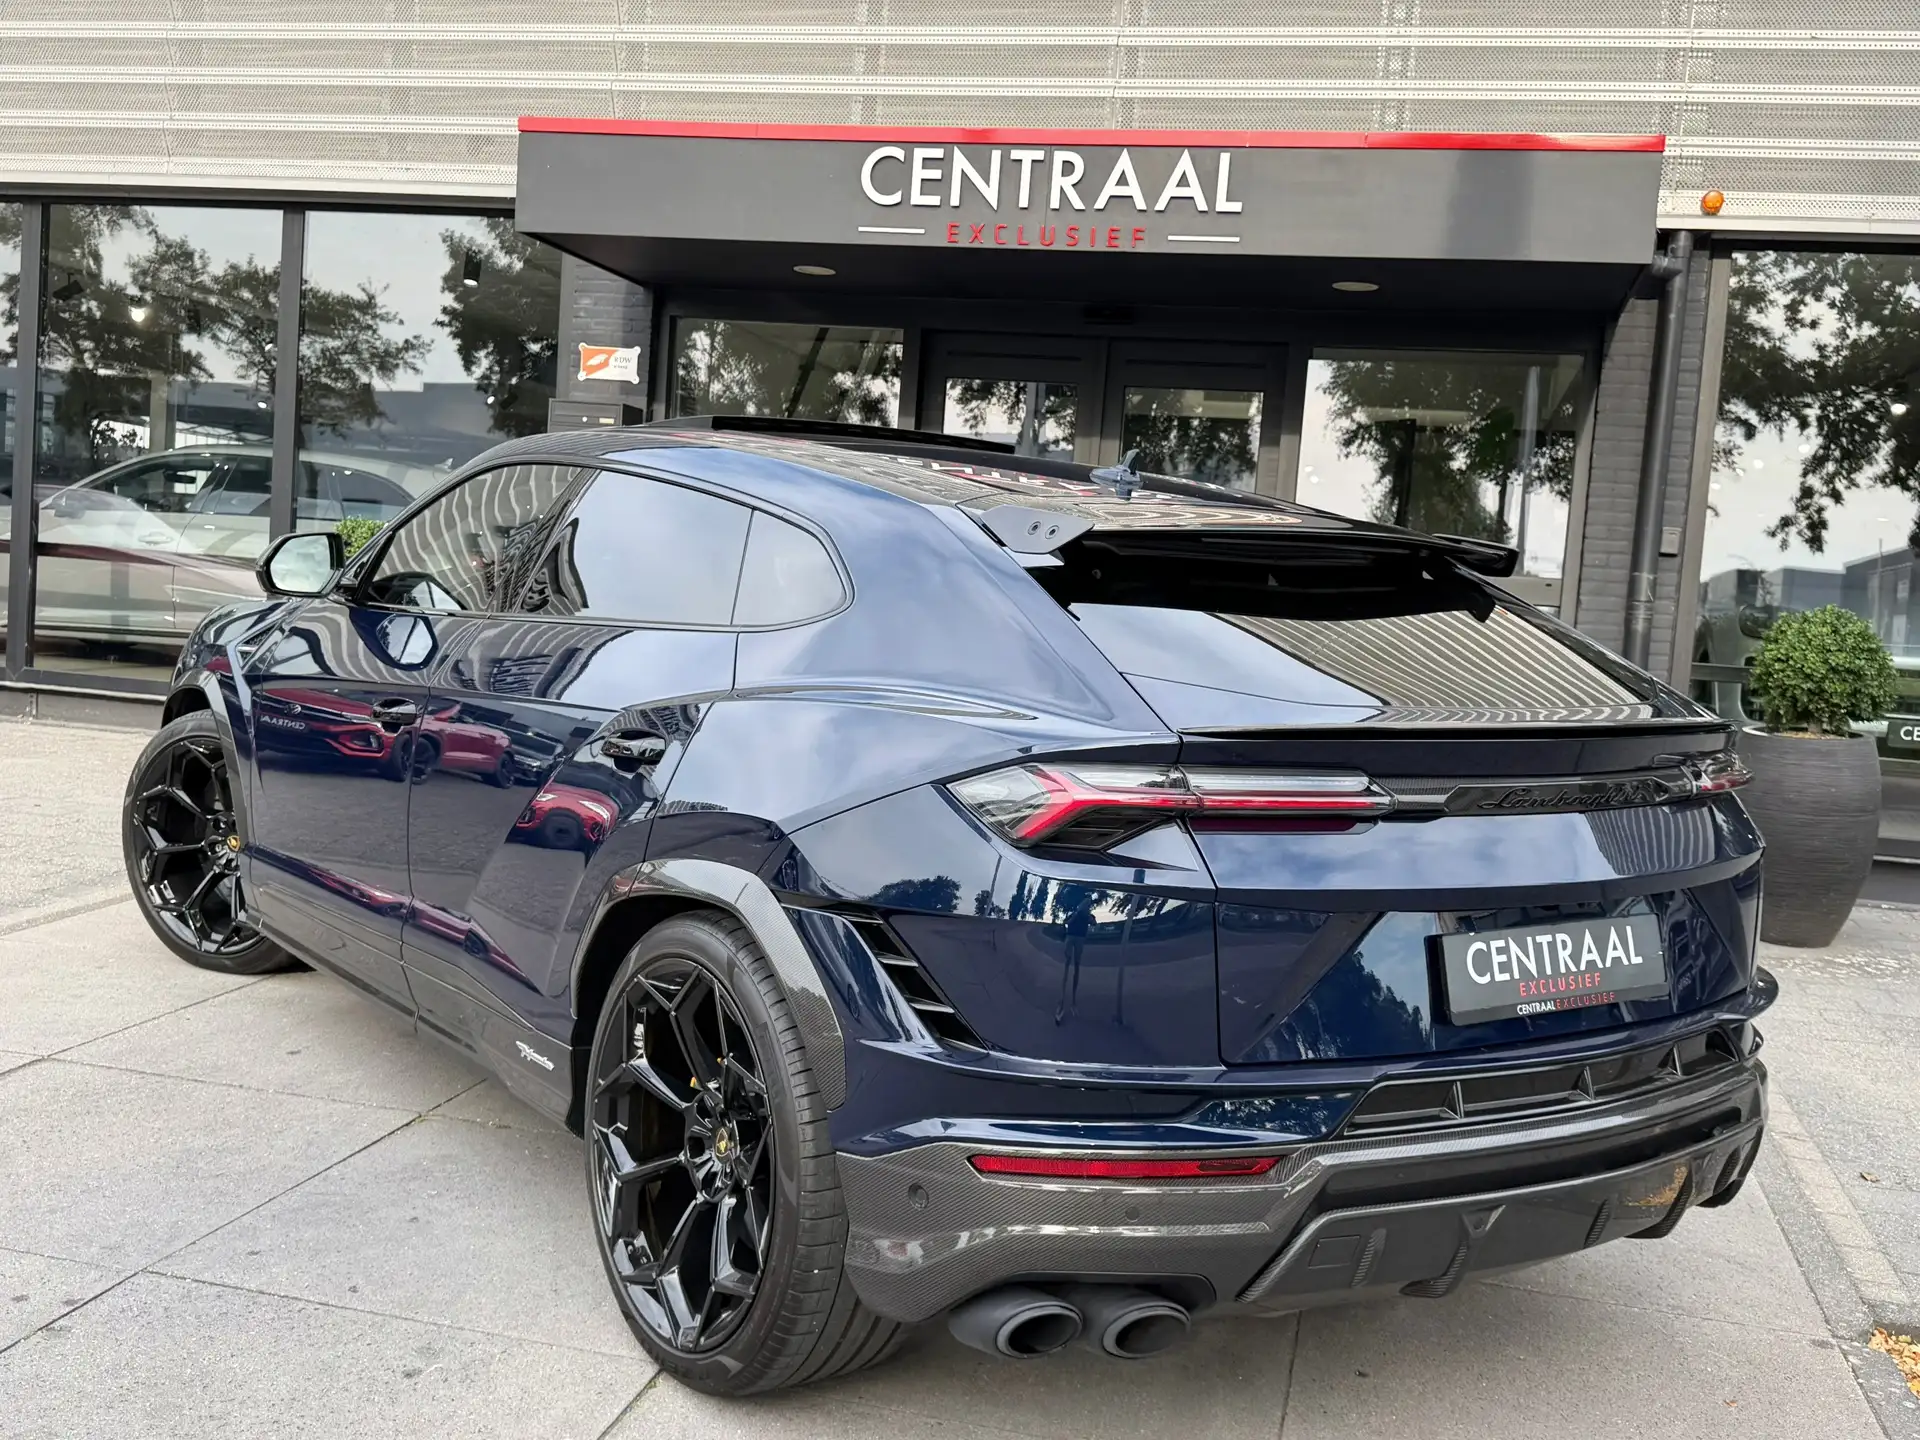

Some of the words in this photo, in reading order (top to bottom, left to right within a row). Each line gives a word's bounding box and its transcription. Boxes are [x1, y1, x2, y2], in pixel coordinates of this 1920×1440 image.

[860, 145, 1243, 213] CENTRAAL
[946, 222, 1148, 248] EXCLUSIEF
[1466, 925, 1643, 985] CENTRAAL
[1519, 972, 1601, 997] EXCLUSIEF
